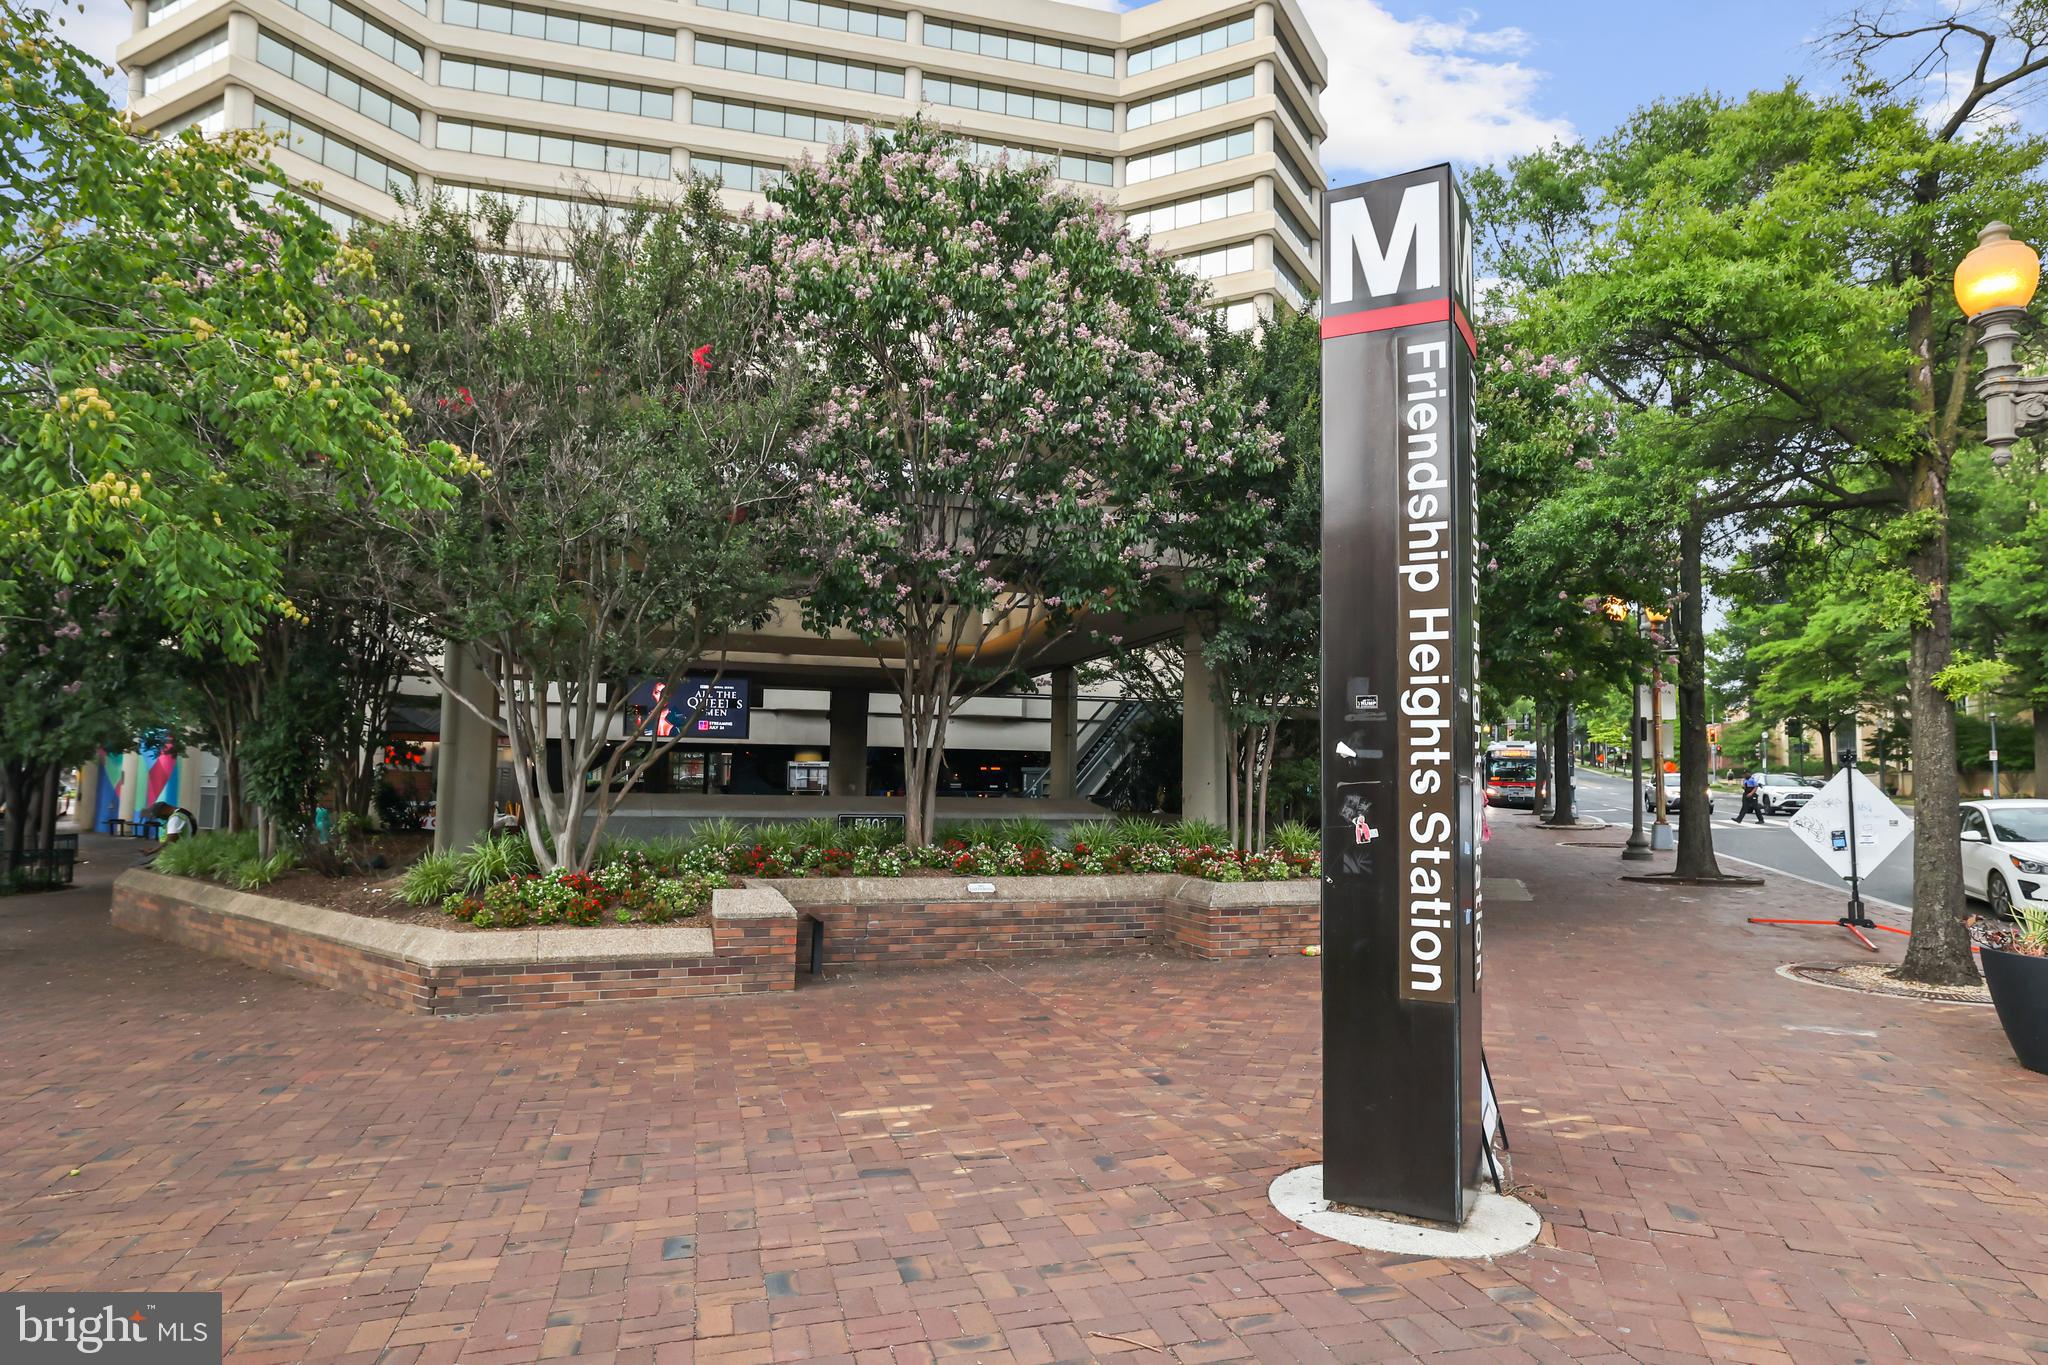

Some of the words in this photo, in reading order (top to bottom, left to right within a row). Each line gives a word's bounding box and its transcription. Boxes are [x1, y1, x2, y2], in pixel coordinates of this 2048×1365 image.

[1330, 181, 1441, 304] M
[1453, 187, 1474, 324] M
[1399, 341, 1449, 593] Friendship
[1471, 369, 1480, 604] Friendship
[1401, 608, 1451, 795] Heights
[1473, 620, 1481, 792] Heights
[1409, 811, 1452, 992] Station
